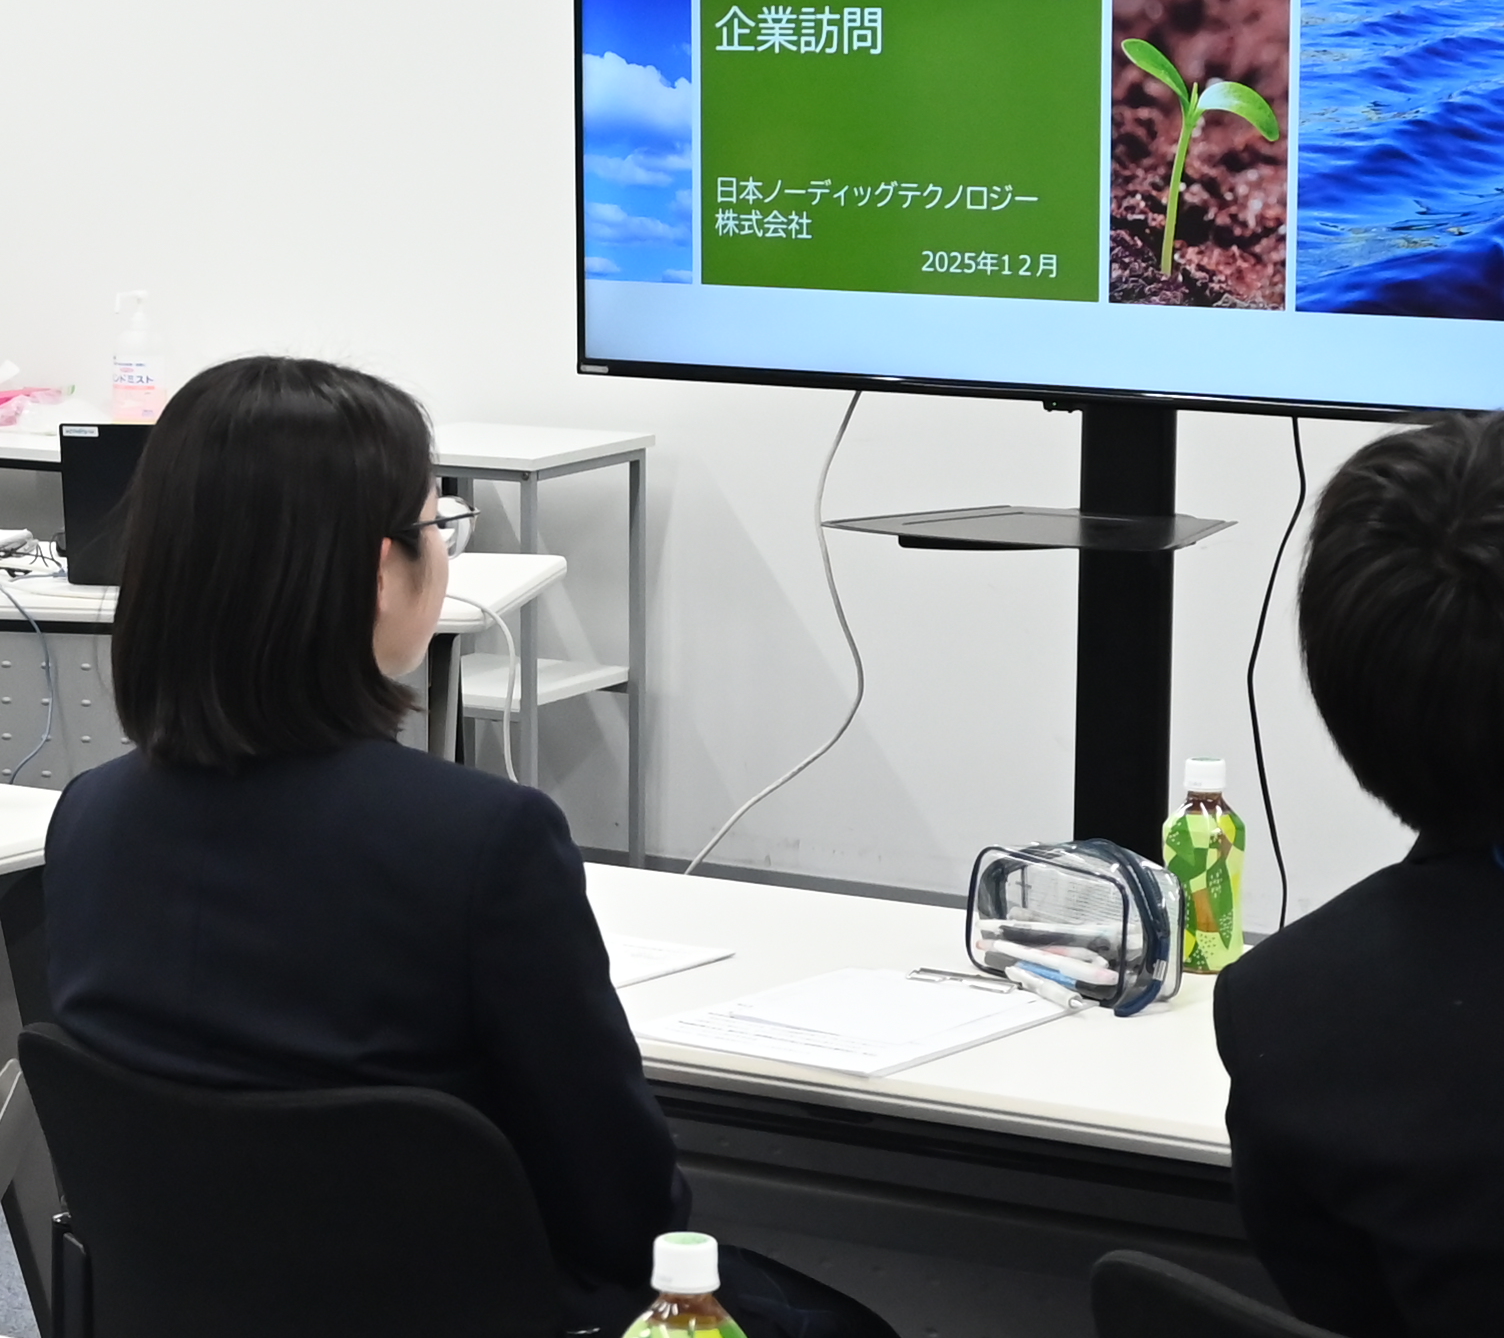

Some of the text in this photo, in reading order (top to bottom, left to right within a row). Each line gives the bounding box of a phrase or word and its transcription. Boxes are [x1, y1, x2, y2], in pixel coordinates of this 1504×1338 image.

[715, 5, 882, 55] 企業訪問
[717, 176, 1039, 211] 日本ノーディッグテクノロジー
[715, 208, 813, 239] 株式会社
